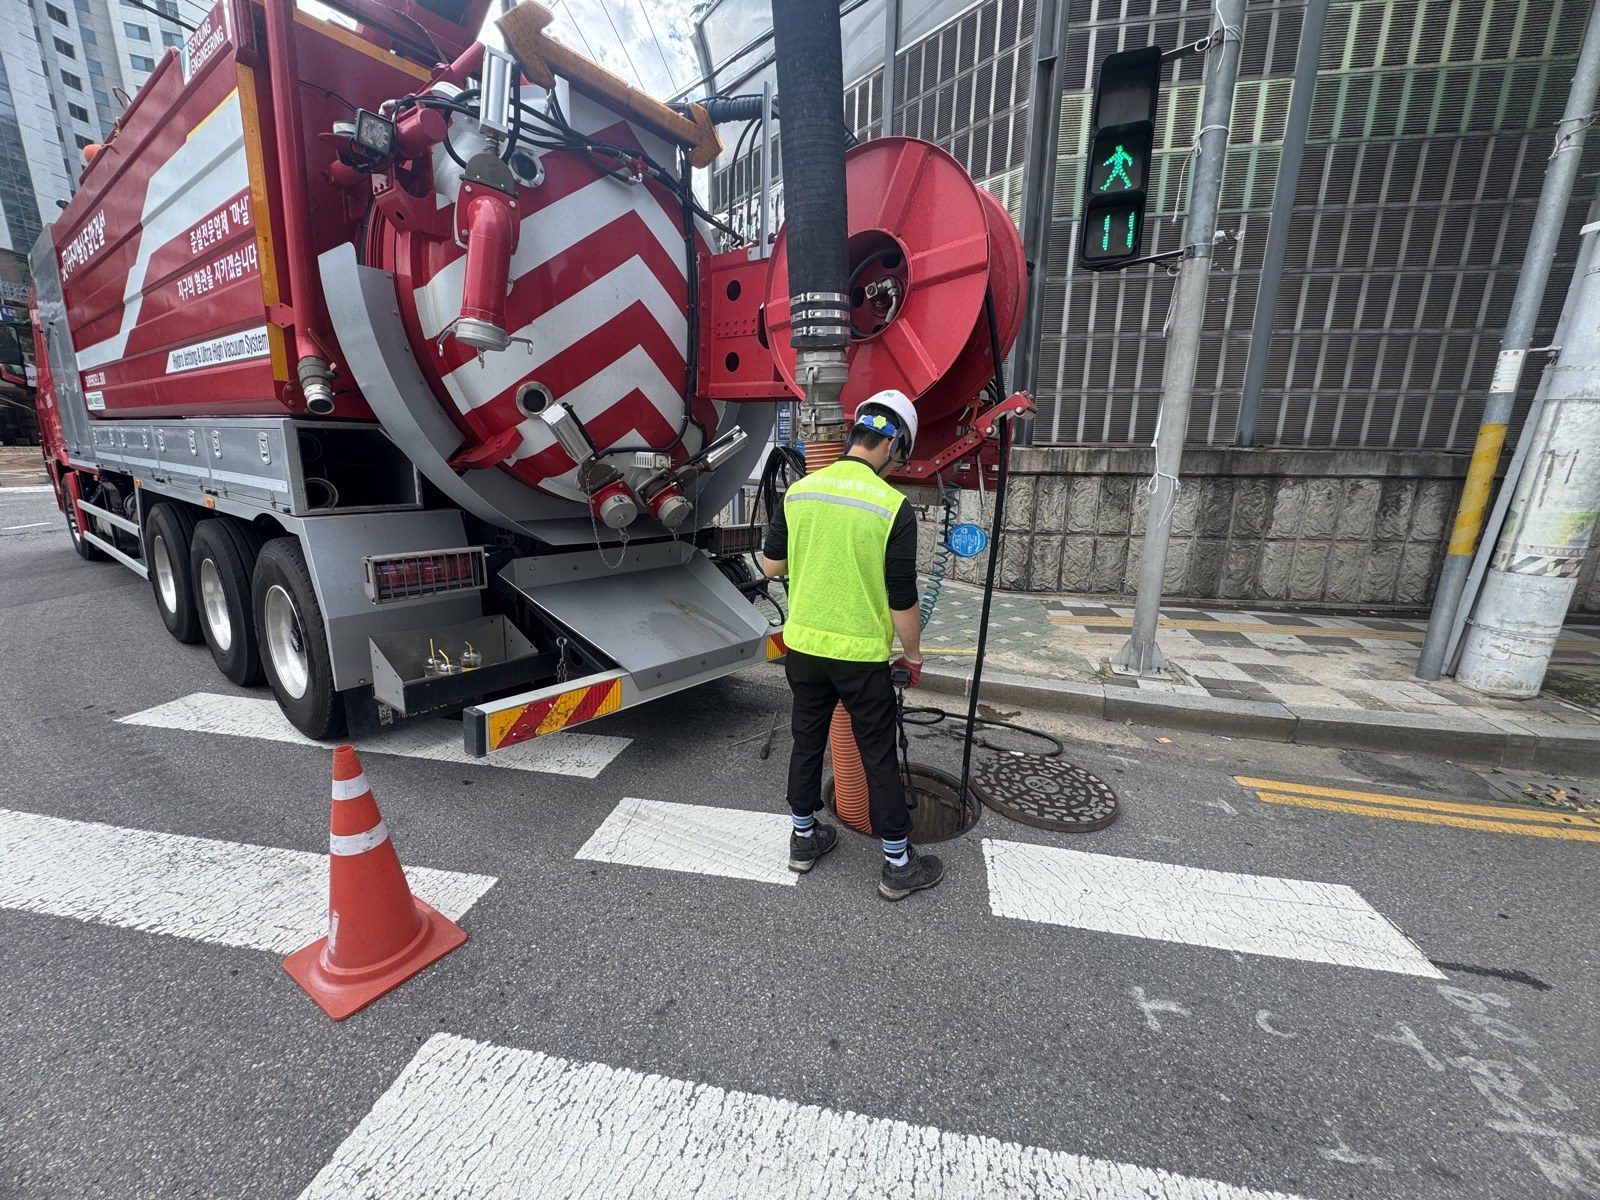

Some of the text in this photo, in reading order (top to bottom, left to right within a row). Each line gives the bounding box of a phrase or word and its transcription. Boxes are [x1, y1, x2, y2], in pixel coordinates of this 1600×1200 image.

[191, 25, 224, 75] ENGINEERING
[190, 210, 230, 255] 준설전문업체
[1102, 211, 1135, 251] 11
[177, 243, 258, 301] 지구의 혈관을 지키겠습니다
[212, 342, 223, 361] High
[223, 339, 246, 358] Vacuum
[245, 334, 268, 355] System
